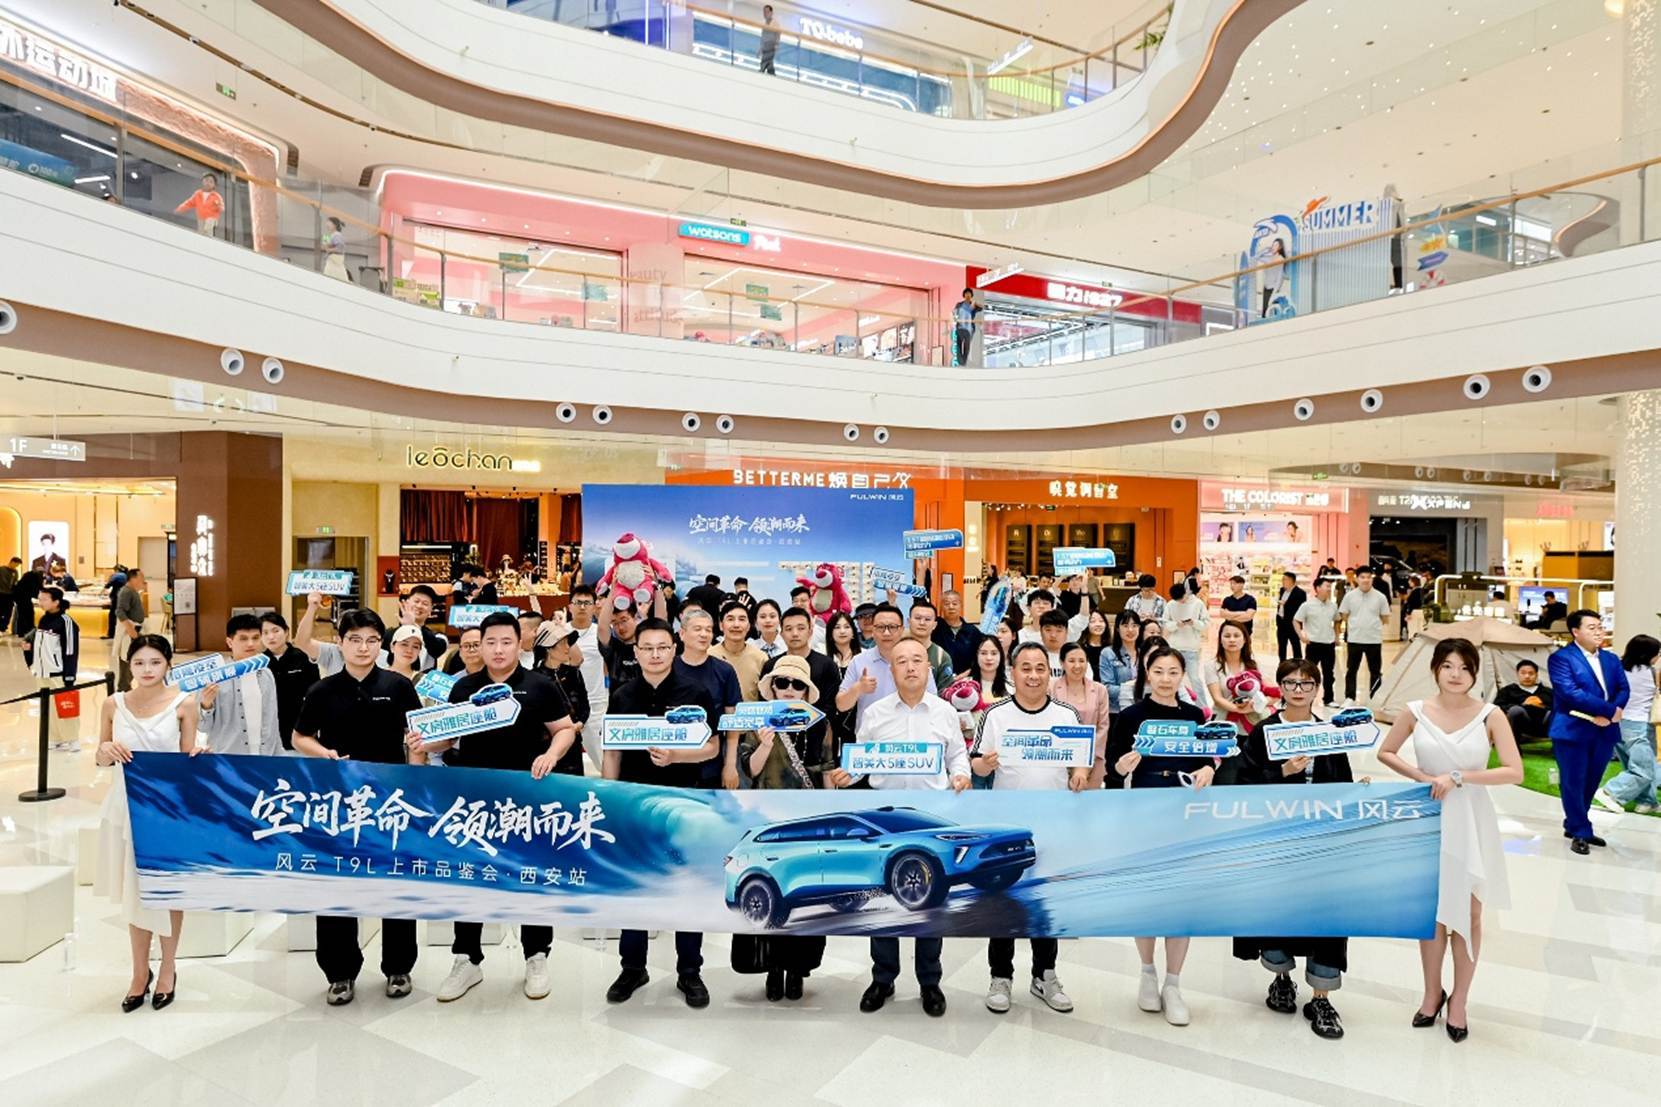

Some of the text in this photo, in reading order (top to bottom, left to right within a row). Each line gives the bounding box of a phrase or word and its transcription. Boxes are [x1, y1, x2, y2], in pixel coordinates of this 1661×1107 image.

[1303, 200, 1377, 230] SUMMER
[688, 226, 742, 243] watsons
[10, 438, 28, 453] 1F
[733, 469, 825, 488] BETTERME
[1221, 488, 1246, 503] THE
[1247, 489, 1303, 506] COLORIST
[1164, 741, 1218, 754] 安全倍增
[250, 778, 616, 857] 空间革命 领潮而来
[1184, 799, 1423, 820] FULWIN 风云
[275, 852, 318, 872] 风云
[334, 856, 376, 874] T9L
